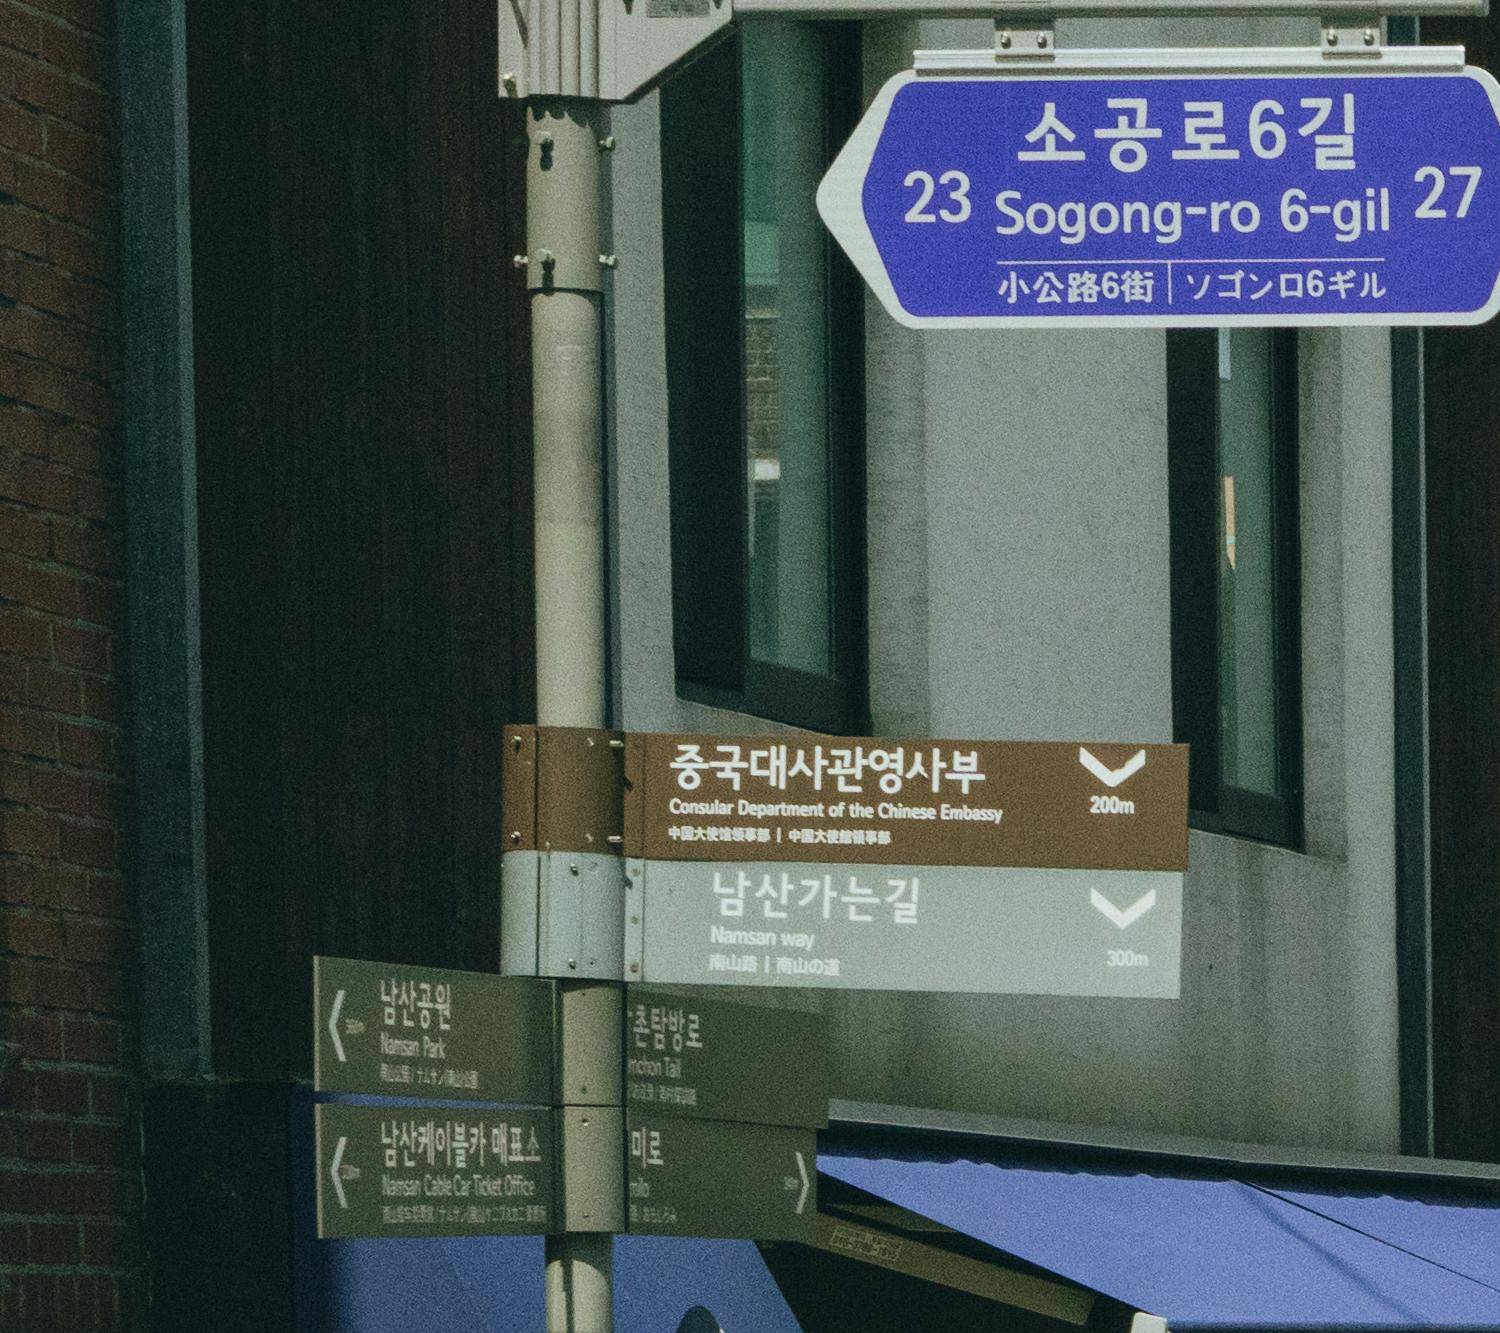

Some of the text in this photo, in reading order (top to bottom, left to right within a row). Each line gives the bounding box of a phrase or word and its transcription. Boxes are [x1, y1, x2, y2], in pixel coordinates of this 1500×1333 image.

[1017, 93, 1357, 171] 소공로6길
[903, 171, 972, 223] 23
[996, 187, 1391, 245] Sogong-ro 6-gil
[1414, 166, 1482, 219] 27
[998, 270, 1153, 304] 小公路6街
[669, 745, 986, 795] 중국대사관영사부
[669, 798, 1002, 826] Consular Department of the Chinese Embassy
[1090, 795, 1134, 815] 200m
[712, 870, 921, 924] 남산가는길
[710, 925, 815, 950] Namsan way
[1107, 948, 1149, 967] 300m
[380, 978, 452, 1031] 남산공원
[627, 1004, 703, 1052] 촌탐방로
[423, 1035, 446, 1059] Park
[381, 1119, 543, 1169] 남산케이블카 매표소
